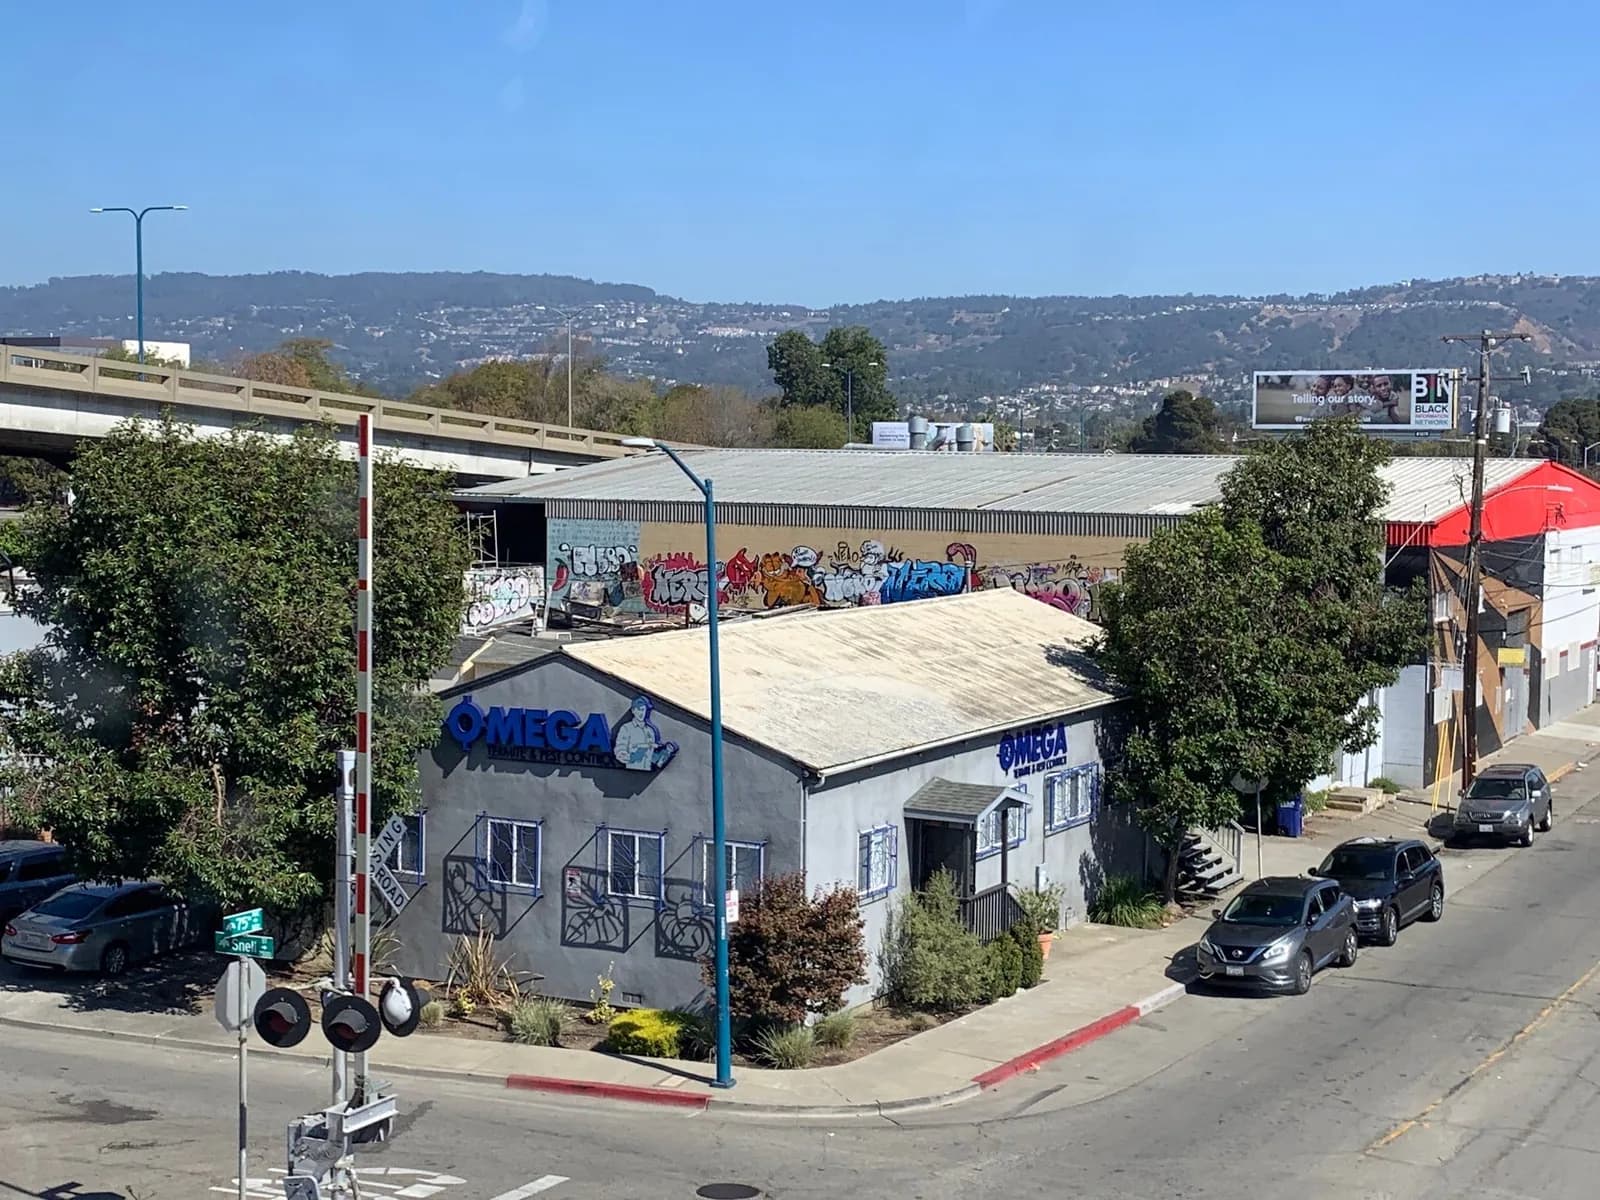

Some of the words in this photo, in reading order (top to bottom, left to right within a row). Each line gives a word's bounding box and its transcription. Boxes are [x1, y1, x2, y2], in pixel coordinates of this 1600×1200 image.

[1292, 393, 1325, 406] Telling
[1328, 395, 1345, 404] our
[1348, 394, 1377, 406] story.
[1416, 375, 1449, 402] BIN
[1415, 404, 1449, 413] BLACK
[446, 696, 613, 752] OMEGA
[997, 722, 1067, 776] OMEGA
[375, 867, 405, 907] ROAD
